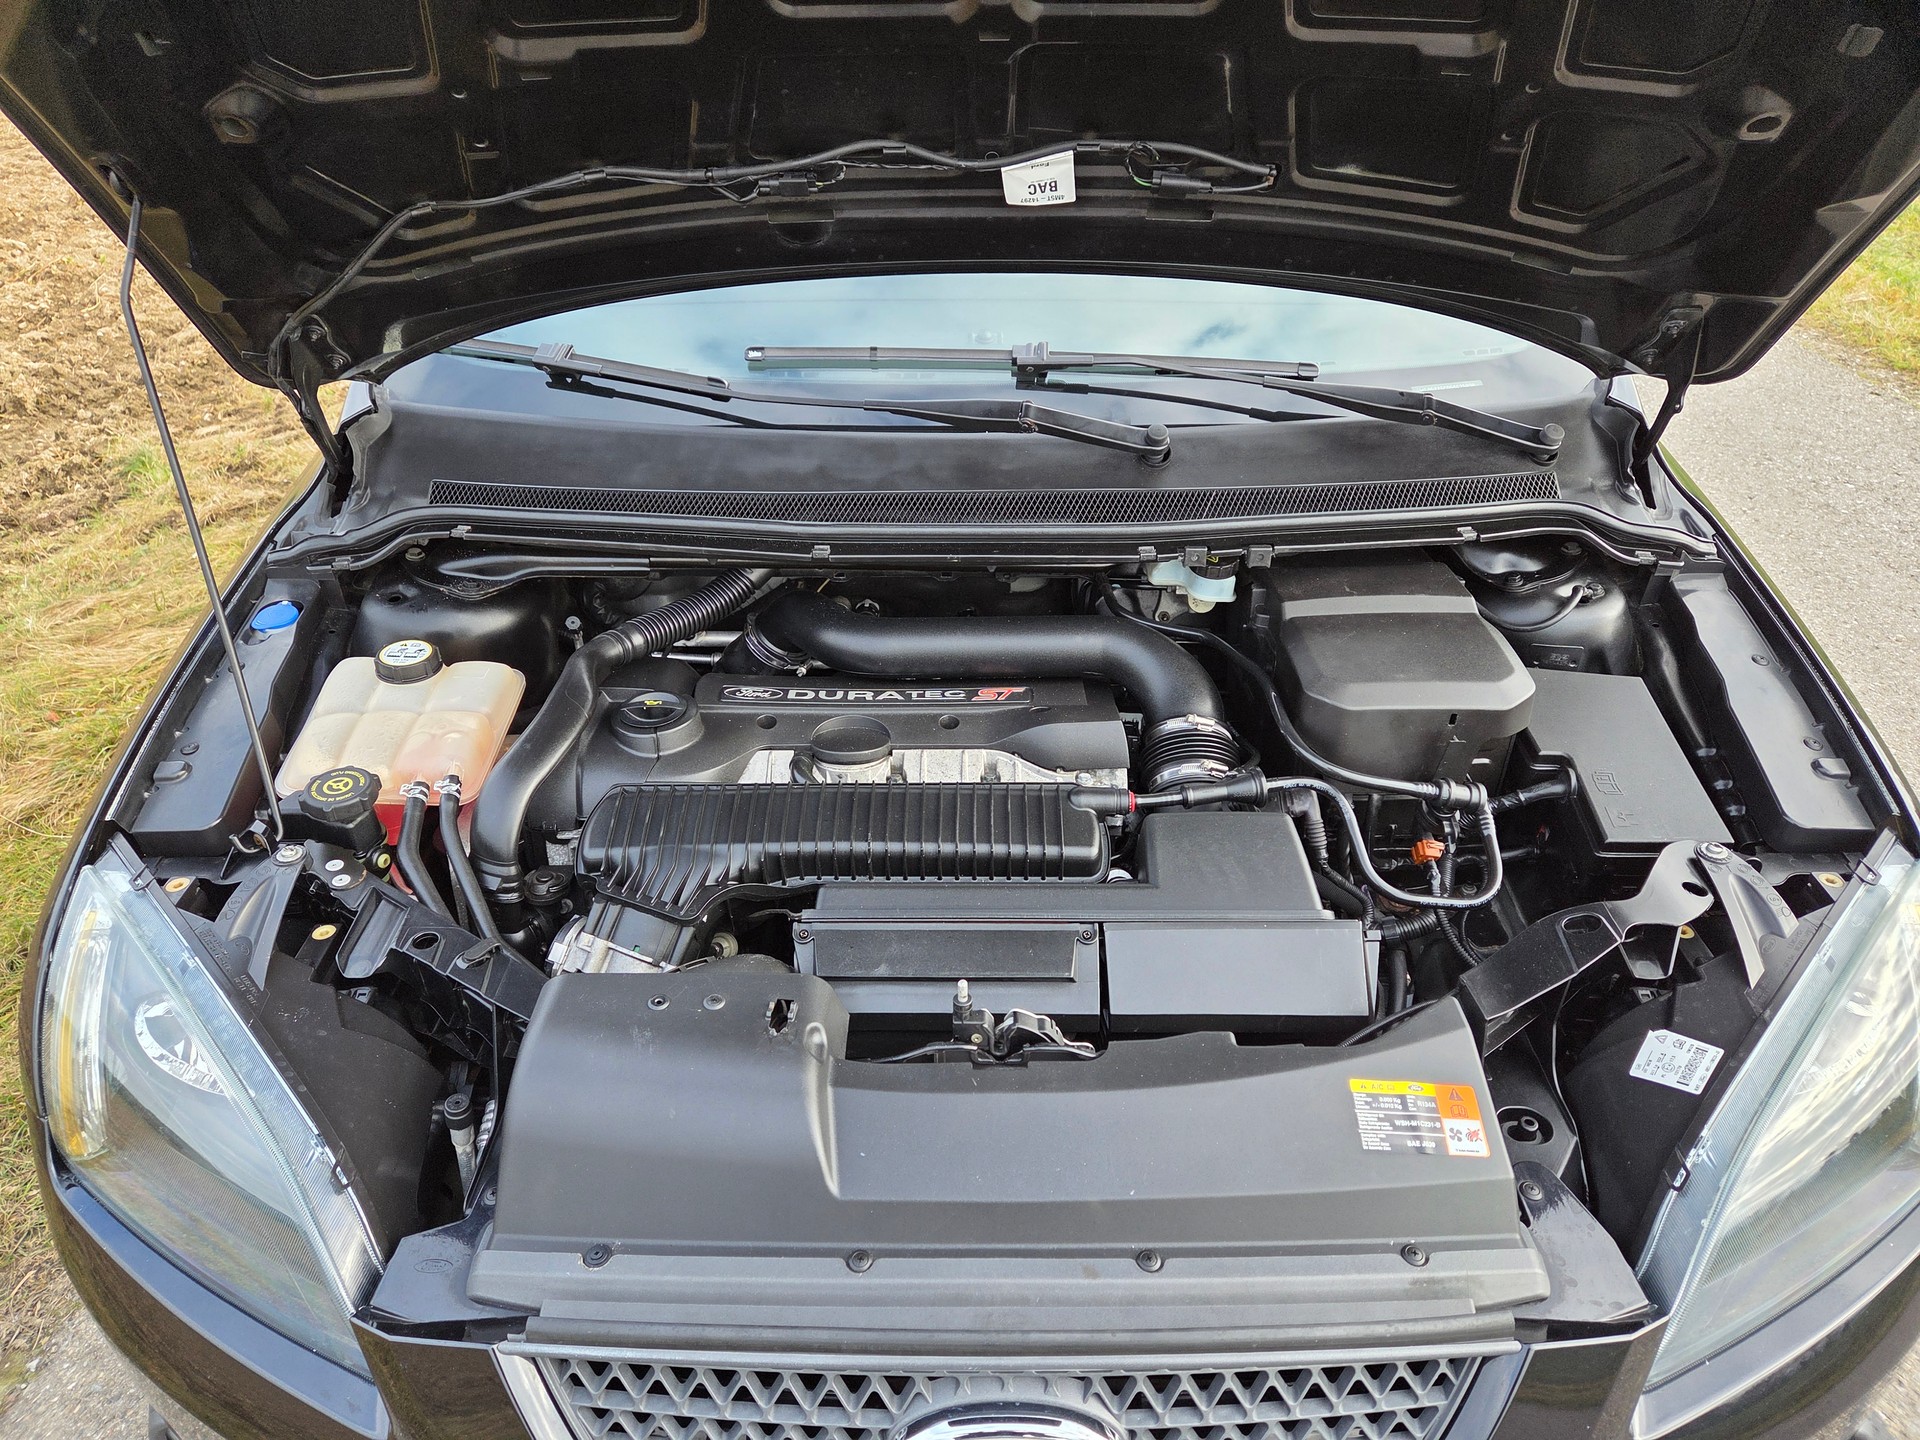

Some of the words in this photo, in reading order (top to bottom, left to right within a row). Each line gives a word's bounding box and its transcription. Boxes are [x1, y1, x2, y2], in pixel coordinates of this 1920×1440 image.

[1028, 180, 1058, 196] BAC
[787, 689, 967, 700] DURATEC
[971, 688, 1026, 700] ST
